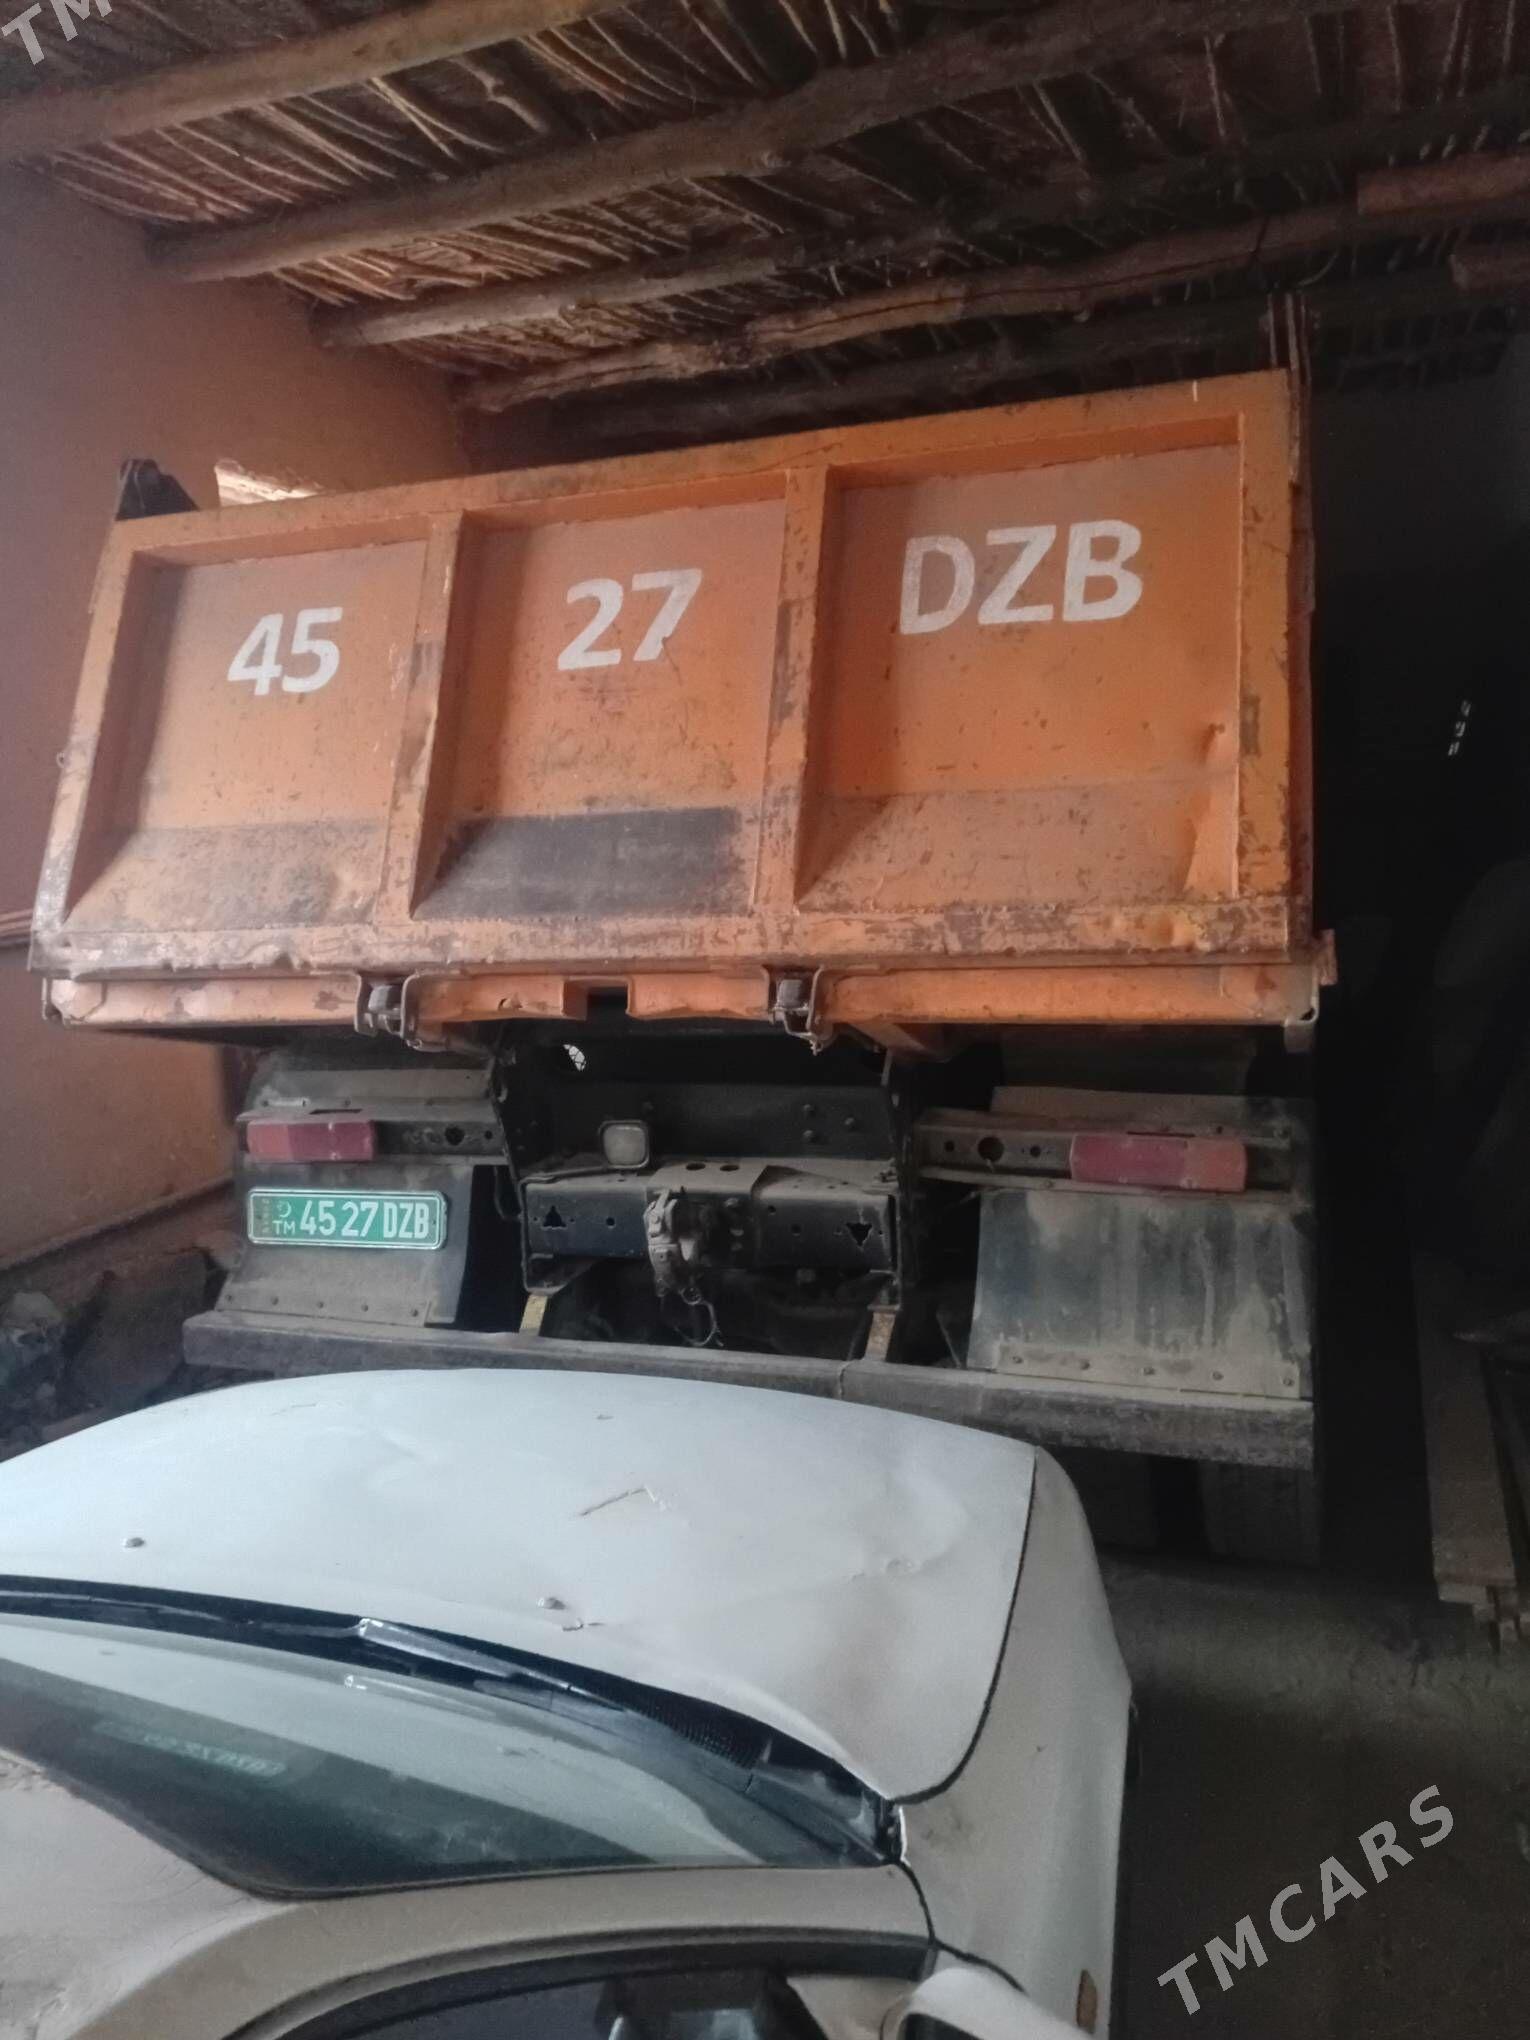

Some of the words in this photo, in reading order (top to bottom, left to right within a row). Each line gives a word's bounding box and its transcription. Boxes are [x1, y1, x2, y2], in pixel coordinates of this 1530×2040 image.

[227, 606, 343, 696] 45
[557, 568, 703, 671] 27
[900, 519, 1143, 635] DZB
[271, 1220, 296, 1235] TM
